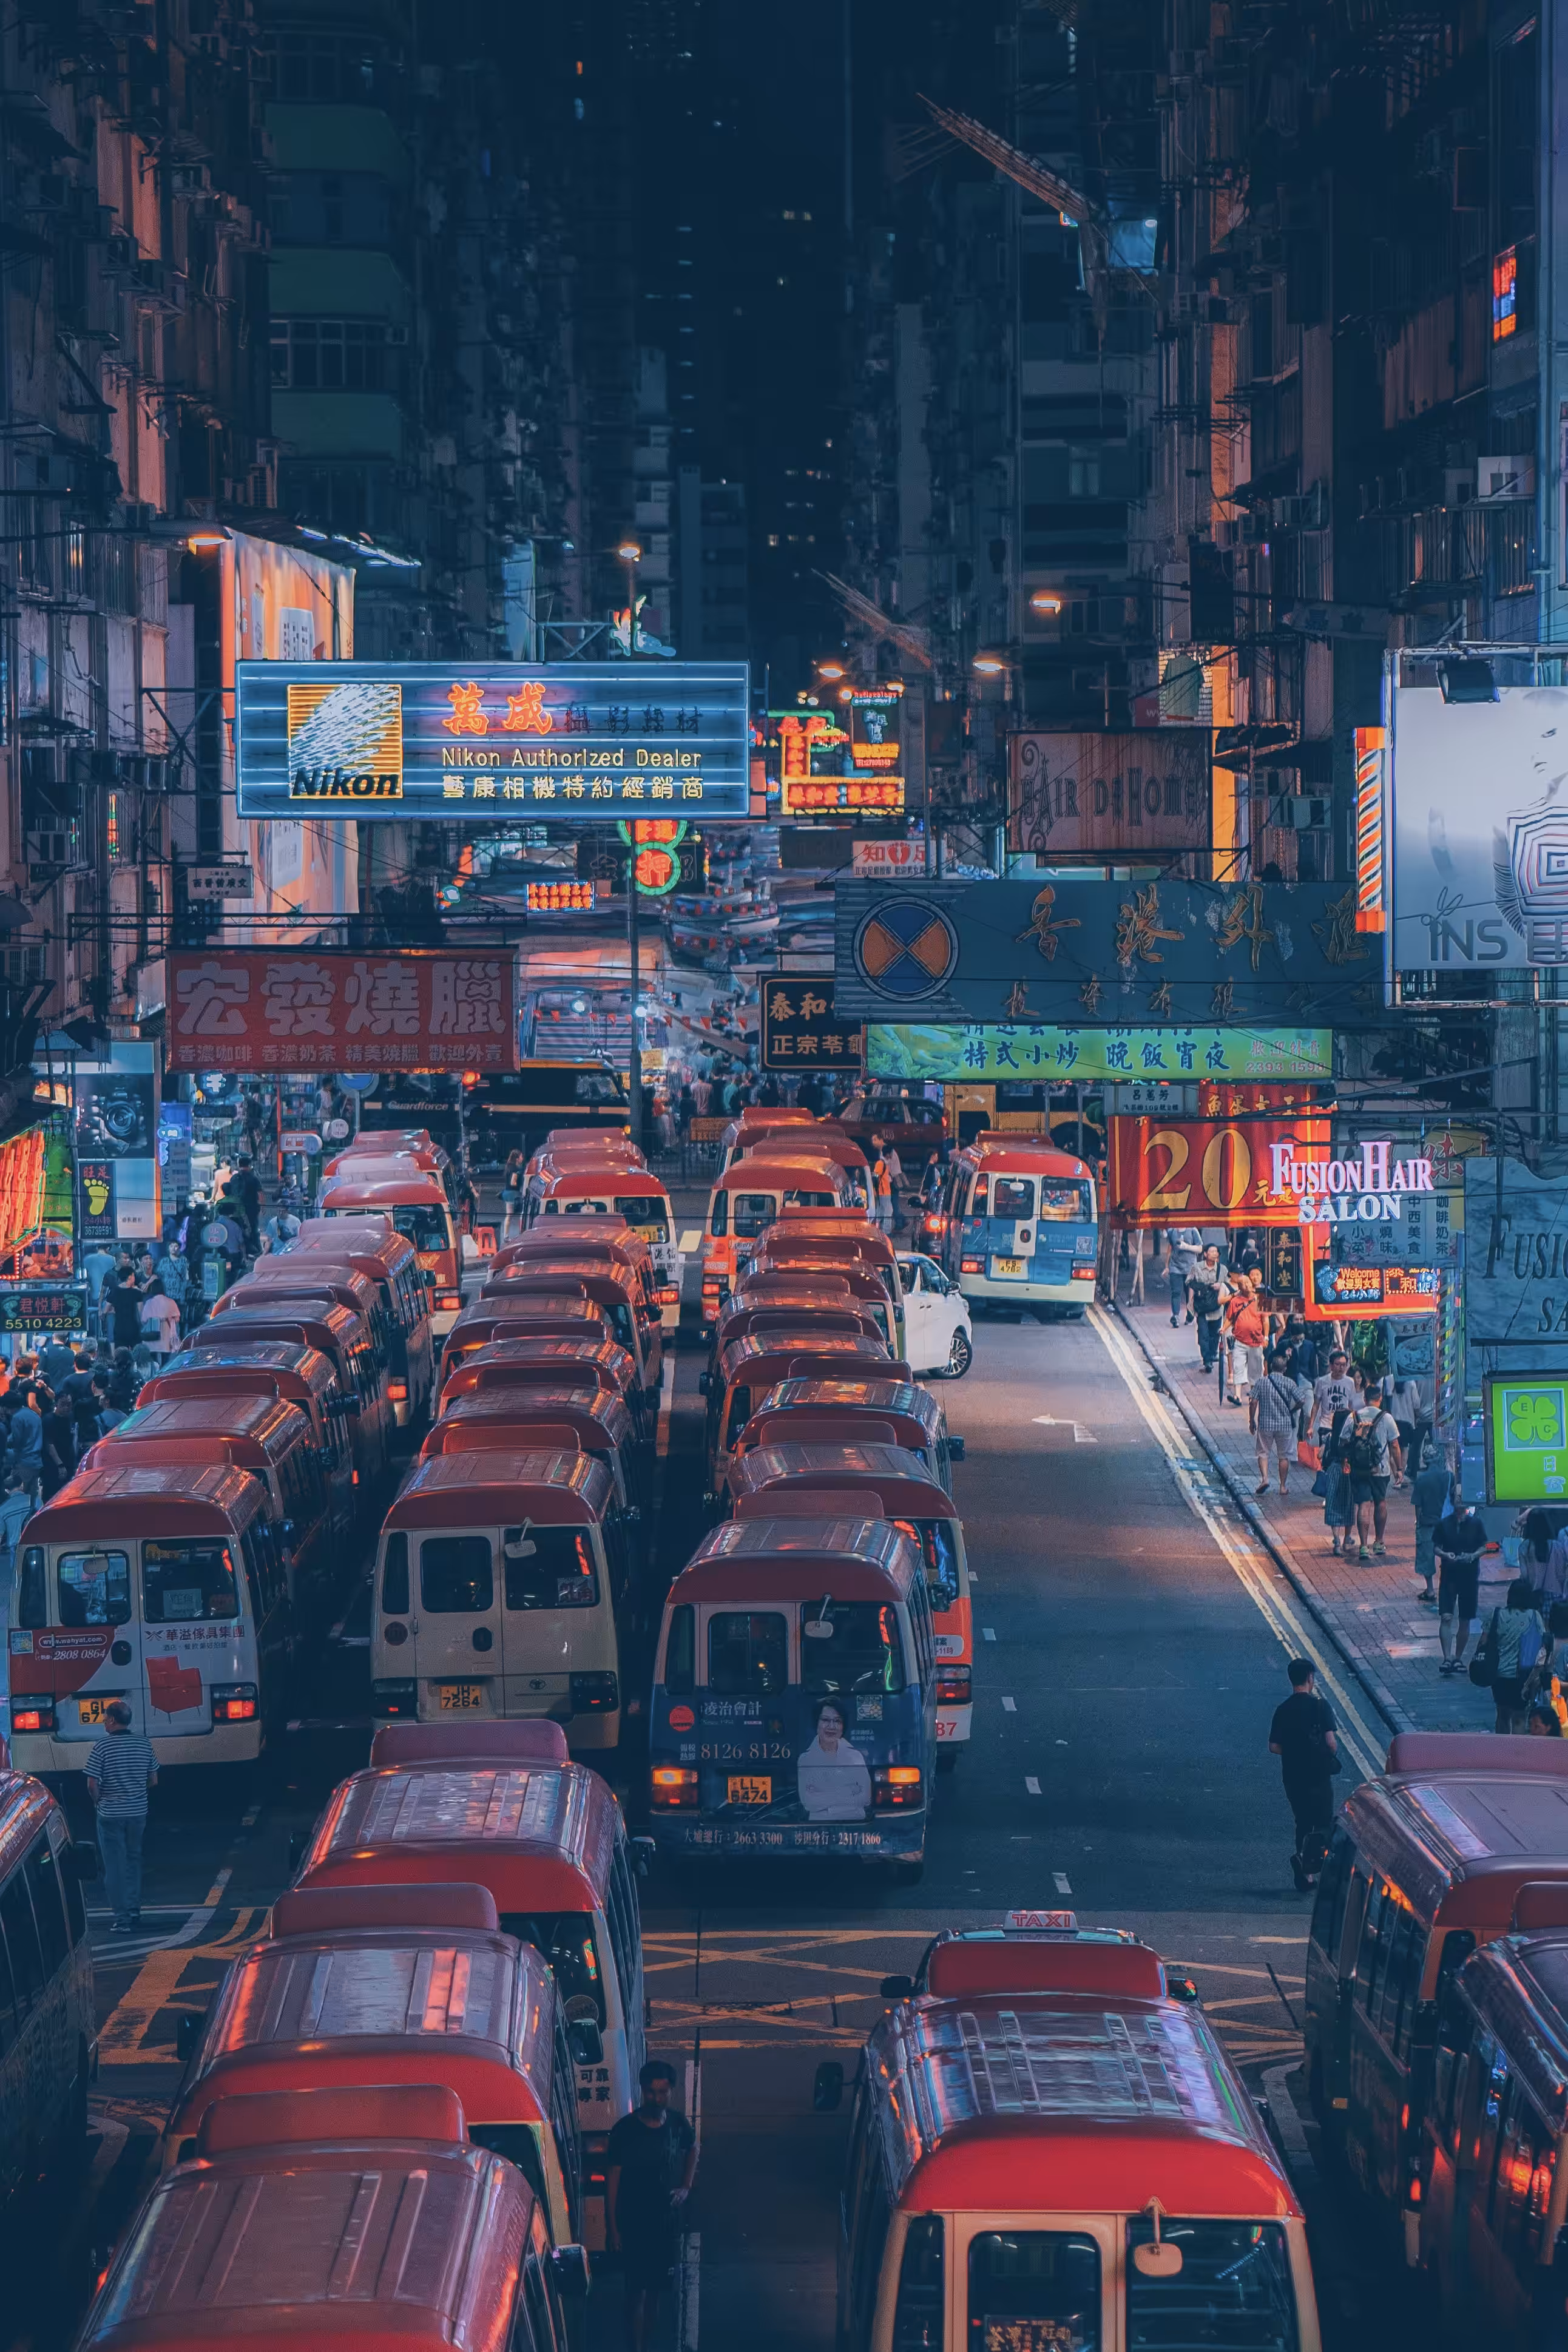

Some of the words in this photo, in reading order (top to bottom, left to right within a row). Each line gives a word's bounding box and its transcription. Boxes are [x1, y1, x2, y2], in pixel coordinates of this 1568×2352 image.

[442, 681, 552, 735] 萬成
[442, 747, 500, 768] Nikon
[636, 748, 702, 768] Dealer
[292, 769, 399, 797] Nikon
[442, 776, 704, 799] 藝康相機特約經銷商
[635, 850, 673, 887] 押
[1430, 919, 1509, 961] INS
[1526, 919, 1568, 961] H
[769, 992, 835, 1021] 泰和
[178, 1044, 252, 1063] 香濃咖啡
[262, 1044, 337, 1063] 香濃奶茶
[962, 1041, 1080, 1070] 特式小炒
[1106, 1041, 1231, 1070] 晚飯宵夜
[1246, 1062, 1284, 1073] 2393
[388, 1101, 448, 1110] Guardforce
[1139, 1128, 1251, 1209] 20
[1299, 1194, 1403, 1223] SALON
[1407, 1195, 1422, 1255] 中西美食
[1435, 1195, 1449, 1255] 咖啡奶茶
[1484, 1214, 1568, 1280] FUSI
[1340, 1268, 1380, 1279] Welcome
[5, 1319, 41, 1329] 5510
[46, 1317, 81, 1328] 4223
[1327, 1385, 1347, 1397] HALL
[1521, 1402, 1528, 1411] E
[1543, 1425, 1551, 1433] C
[53, 1650, 78, 1660] 2808
[81, 1649, 106, 1660] 0864
[442, 1695, 481, 1708] 7264
[701, 1743, 743, 1759] 8126
[748, 1742, 791, 1759] 8126
[740, 1778, 759, 1790] LL
[733, 1831, 757, 1845] 2663
[759, 1831, 783, 1845] 3300
[861, 1831, 881, 1845] 1866
[1012, 1913, 1071, 1928] TAXI
